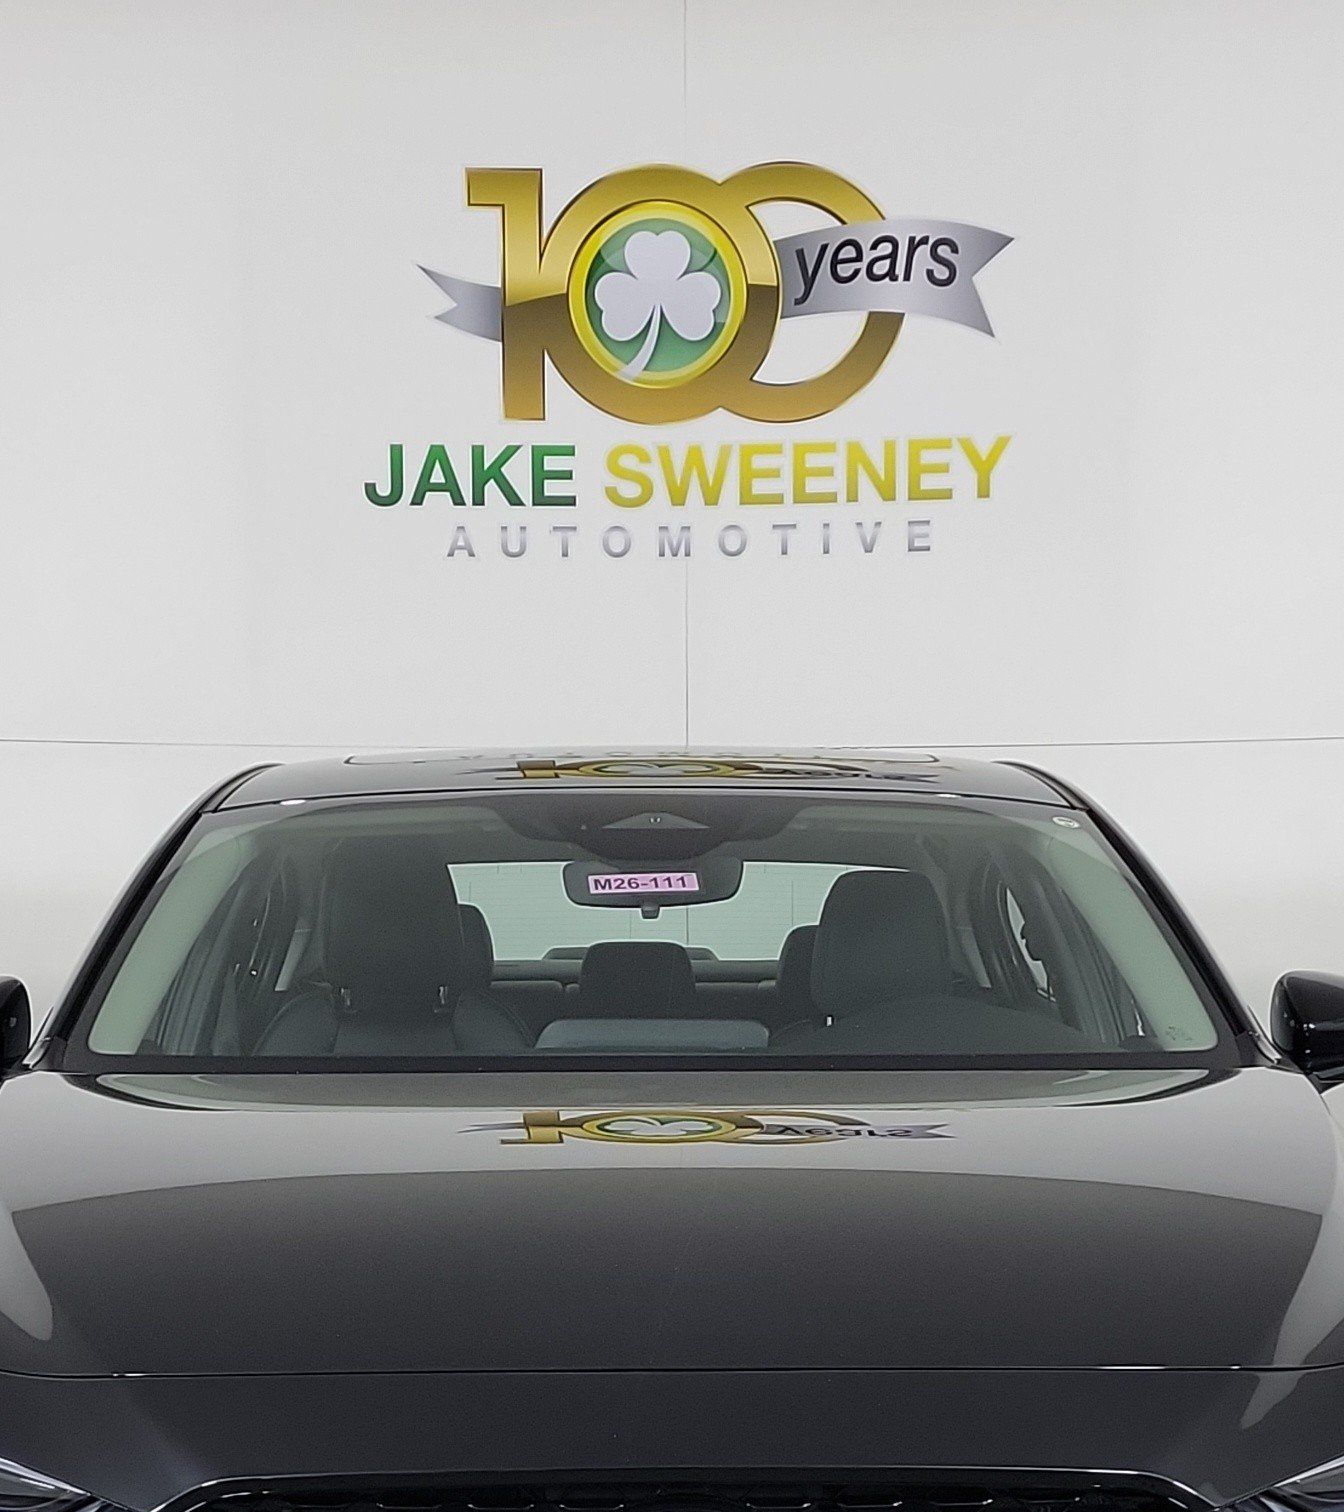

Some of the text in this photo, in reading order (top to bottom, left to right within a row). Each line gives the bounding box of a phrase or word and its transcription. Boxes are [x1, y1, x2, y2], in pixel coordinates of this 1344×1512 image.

[465, 161, 960, 425] 100 years
[364, 435, 1012, 508] JAKE SWEENEY
[446, 519, 933, 558] AUTOMOTIVE
[593, 876, 688, 891] M26-111
